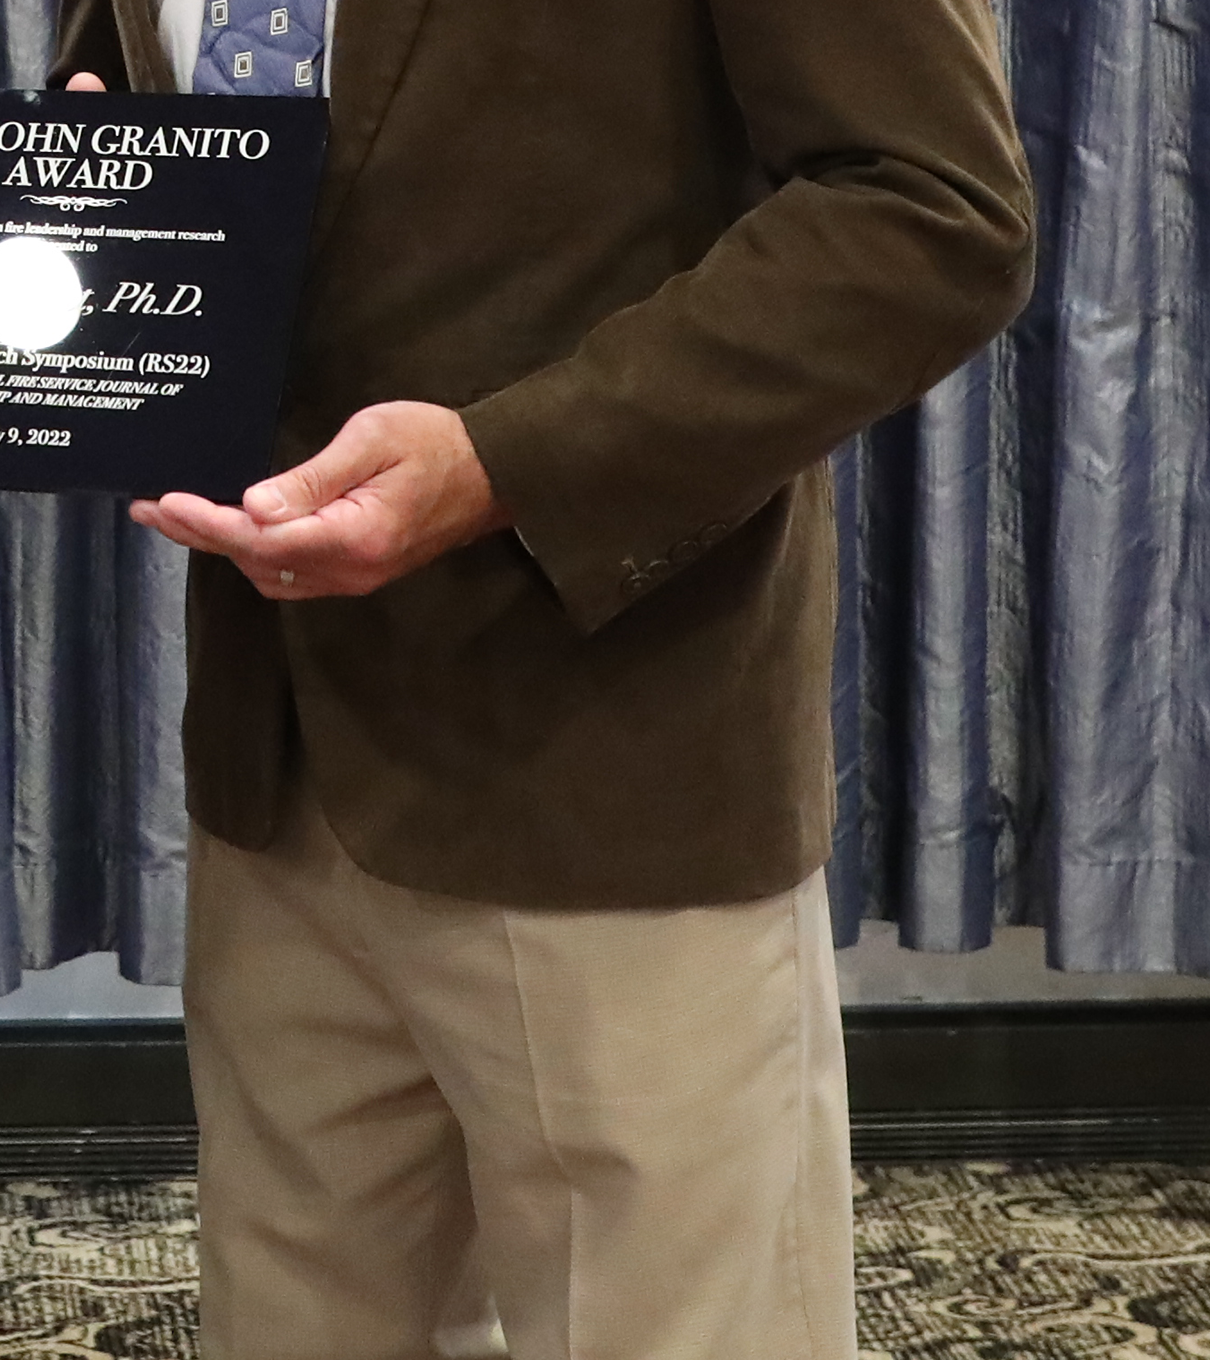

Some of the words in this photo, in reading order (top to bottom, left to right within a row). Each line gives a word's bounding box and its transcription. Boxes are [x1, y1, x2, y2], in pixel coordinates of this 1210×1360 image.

[91, 124, 270, 160] GRANITO
[1, 155, 153, 190] AWARD
[4, 221, 24, 234] fire
[25, 222, 82, 239] leadership
[83, 225, 105, 237] and
[106, 228, 176, 241] management
[178, 230, 226, 242] research
[85, 242, 98, 252] to
[102, 281, 202, 317] Ph.D.
[21, 348, 134, 373] Symposium
[138, 352, 210, 379] (RS22)
[5, 374, 41, 388] FIRE
[39, 376, 96, 391] SERVICE
[92, 380, 159, 395] JOURNAL
[160, 383, 184, 397] OF
[9, 392, 44, 406] AND
[41, 393, 145, 411] MANAGEMENT
[7, 427, 23, 445] 9,
[26, 428, 71, 447] 2022
